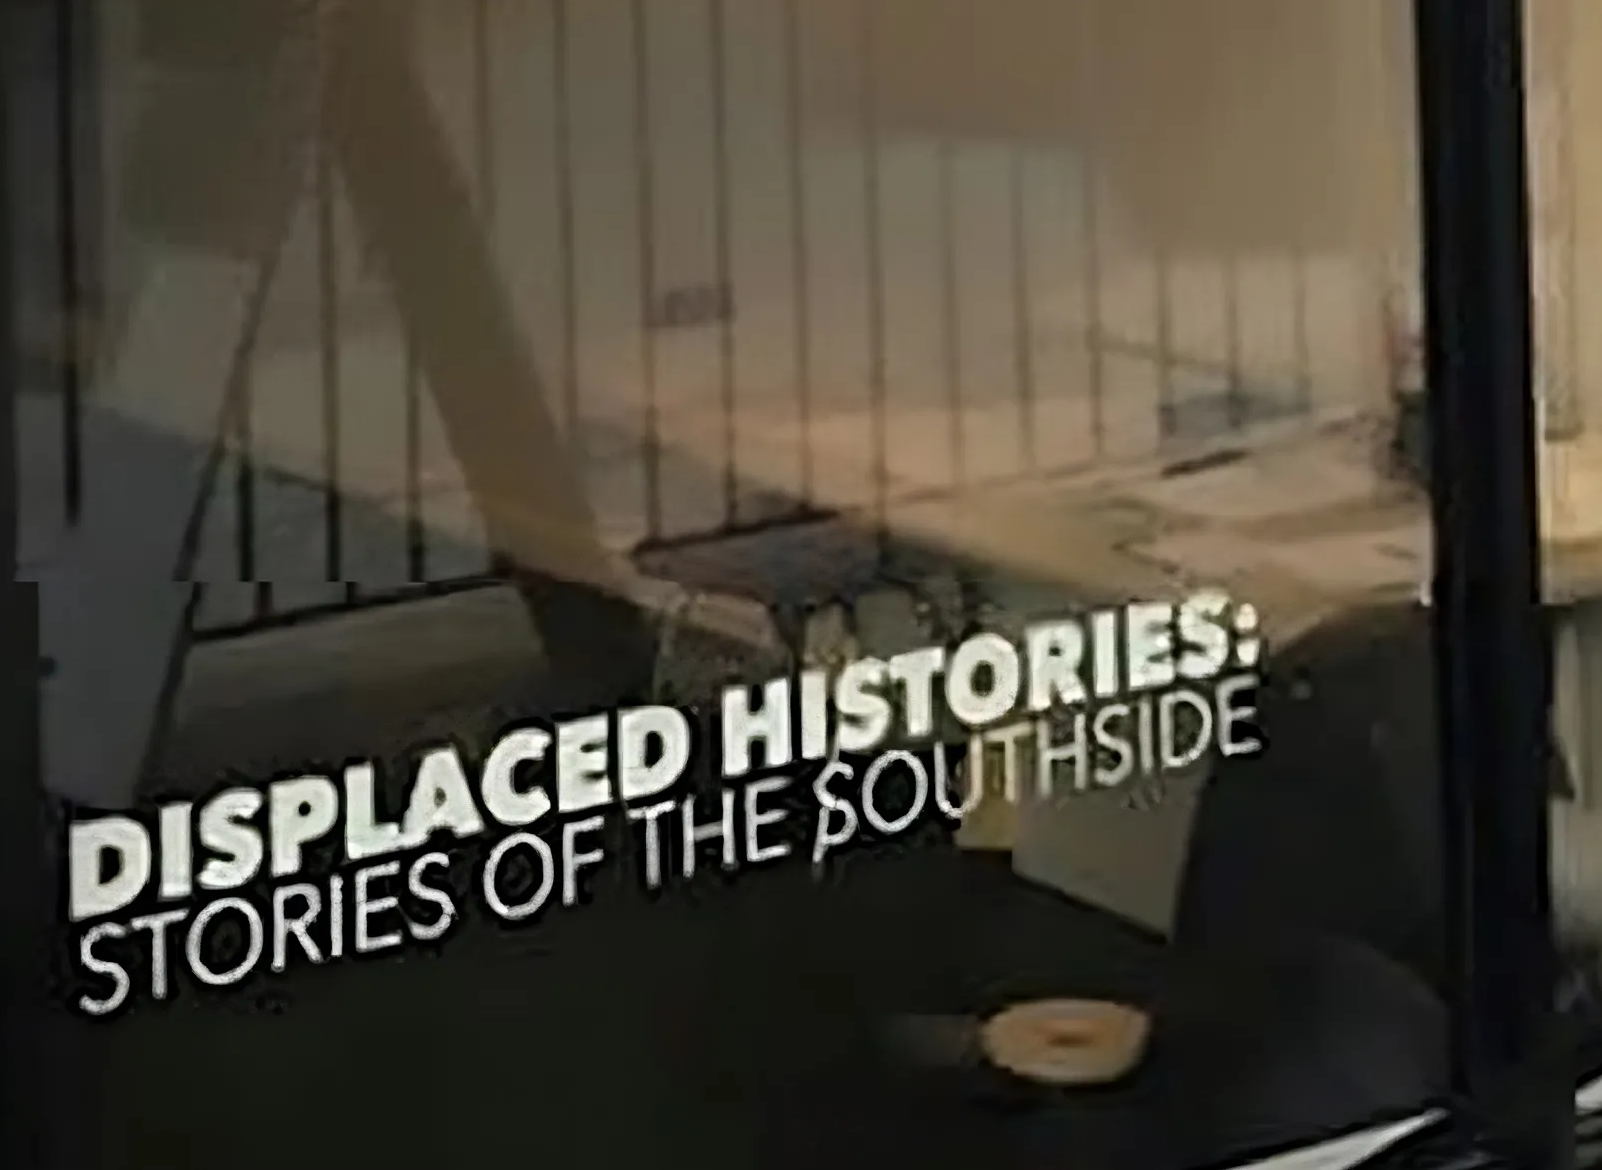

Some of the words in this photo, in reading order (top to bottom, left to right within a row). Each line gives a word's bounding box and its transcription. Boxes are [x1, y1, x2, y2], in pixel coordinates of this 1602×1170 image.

[68, 704, 691, 922] DISPLACED
[720, 588, 1259, 780] HISTORIES:
[78, 851, 459, 1016] STORIES
[483, 815, 606, 920] OF
[626, 774, 795, 890] THE
[812, 674, 1263, 875] SOUTHSIDE
